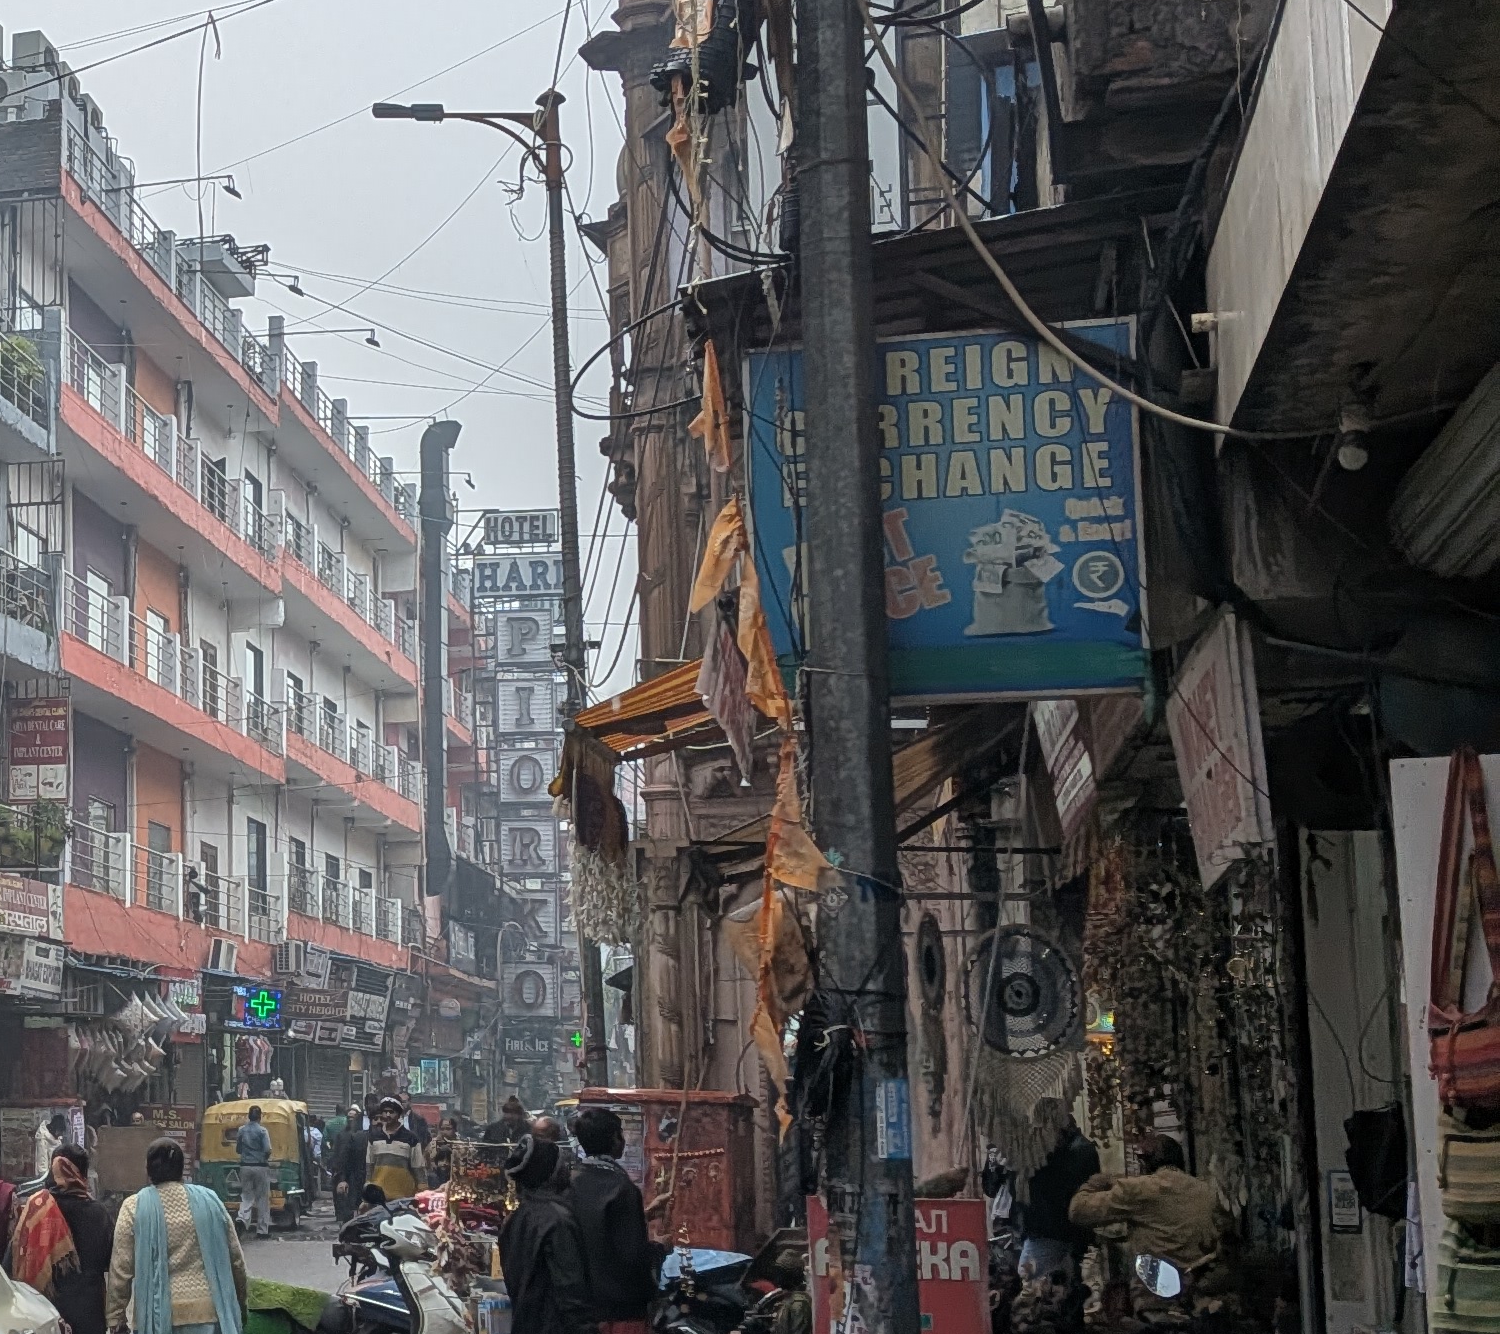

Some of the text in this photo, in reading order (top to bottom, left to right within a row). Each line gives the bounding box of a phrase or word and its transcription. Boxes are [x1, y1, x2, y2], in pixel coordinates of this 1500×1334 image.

[885, 339, 1074, 396] REIGN
[776, 387, 1113, 458] CRRENCY
[782, 442, 1112, 508] EHANGE
[485, 515, 555, 542] HOTEL
[299, 992, 332, 1005] HOTEL
[152, 1108, 182, 1120] M.S.
[168, 1120, 195, 1130] SALON
